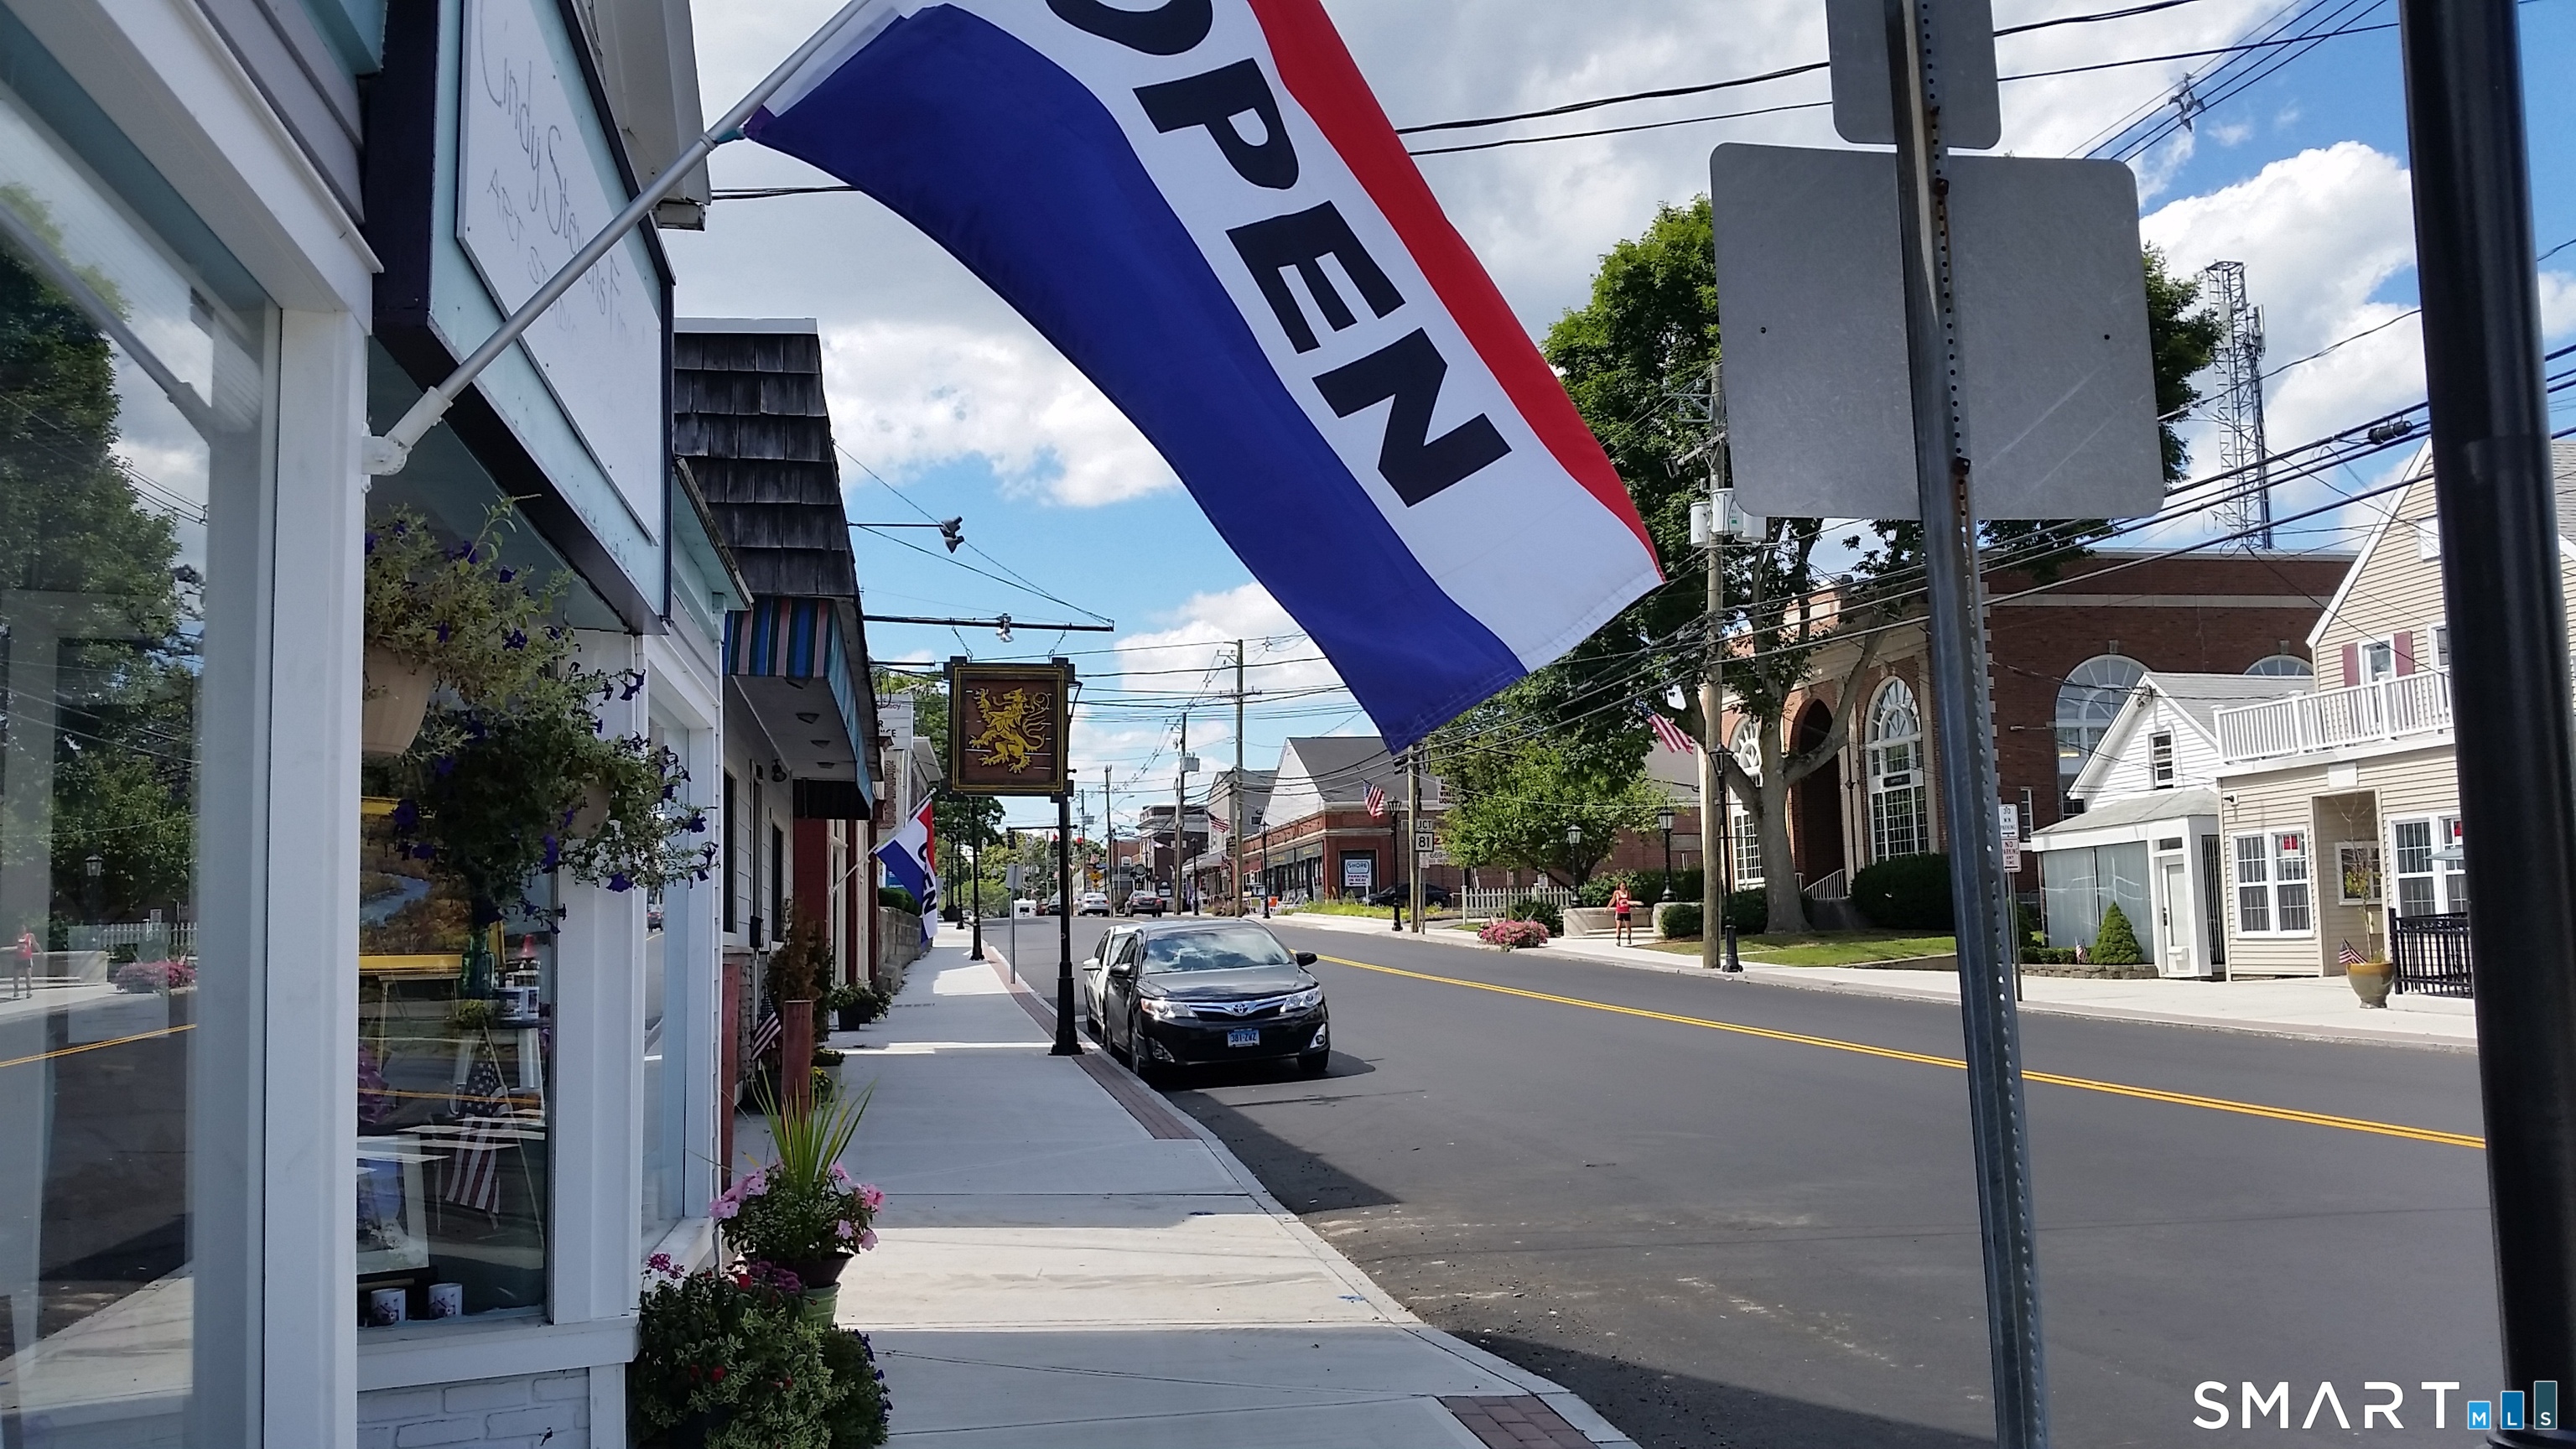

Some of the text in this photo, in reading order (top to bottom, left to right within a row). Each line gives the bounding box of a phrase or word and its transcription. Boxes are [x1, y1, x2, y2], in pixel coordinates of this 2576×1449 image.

[486, 169, 526, 256] ART
[1417, 820, 1431, 829] JCT
[1418, 836, 1430, 848] 81
